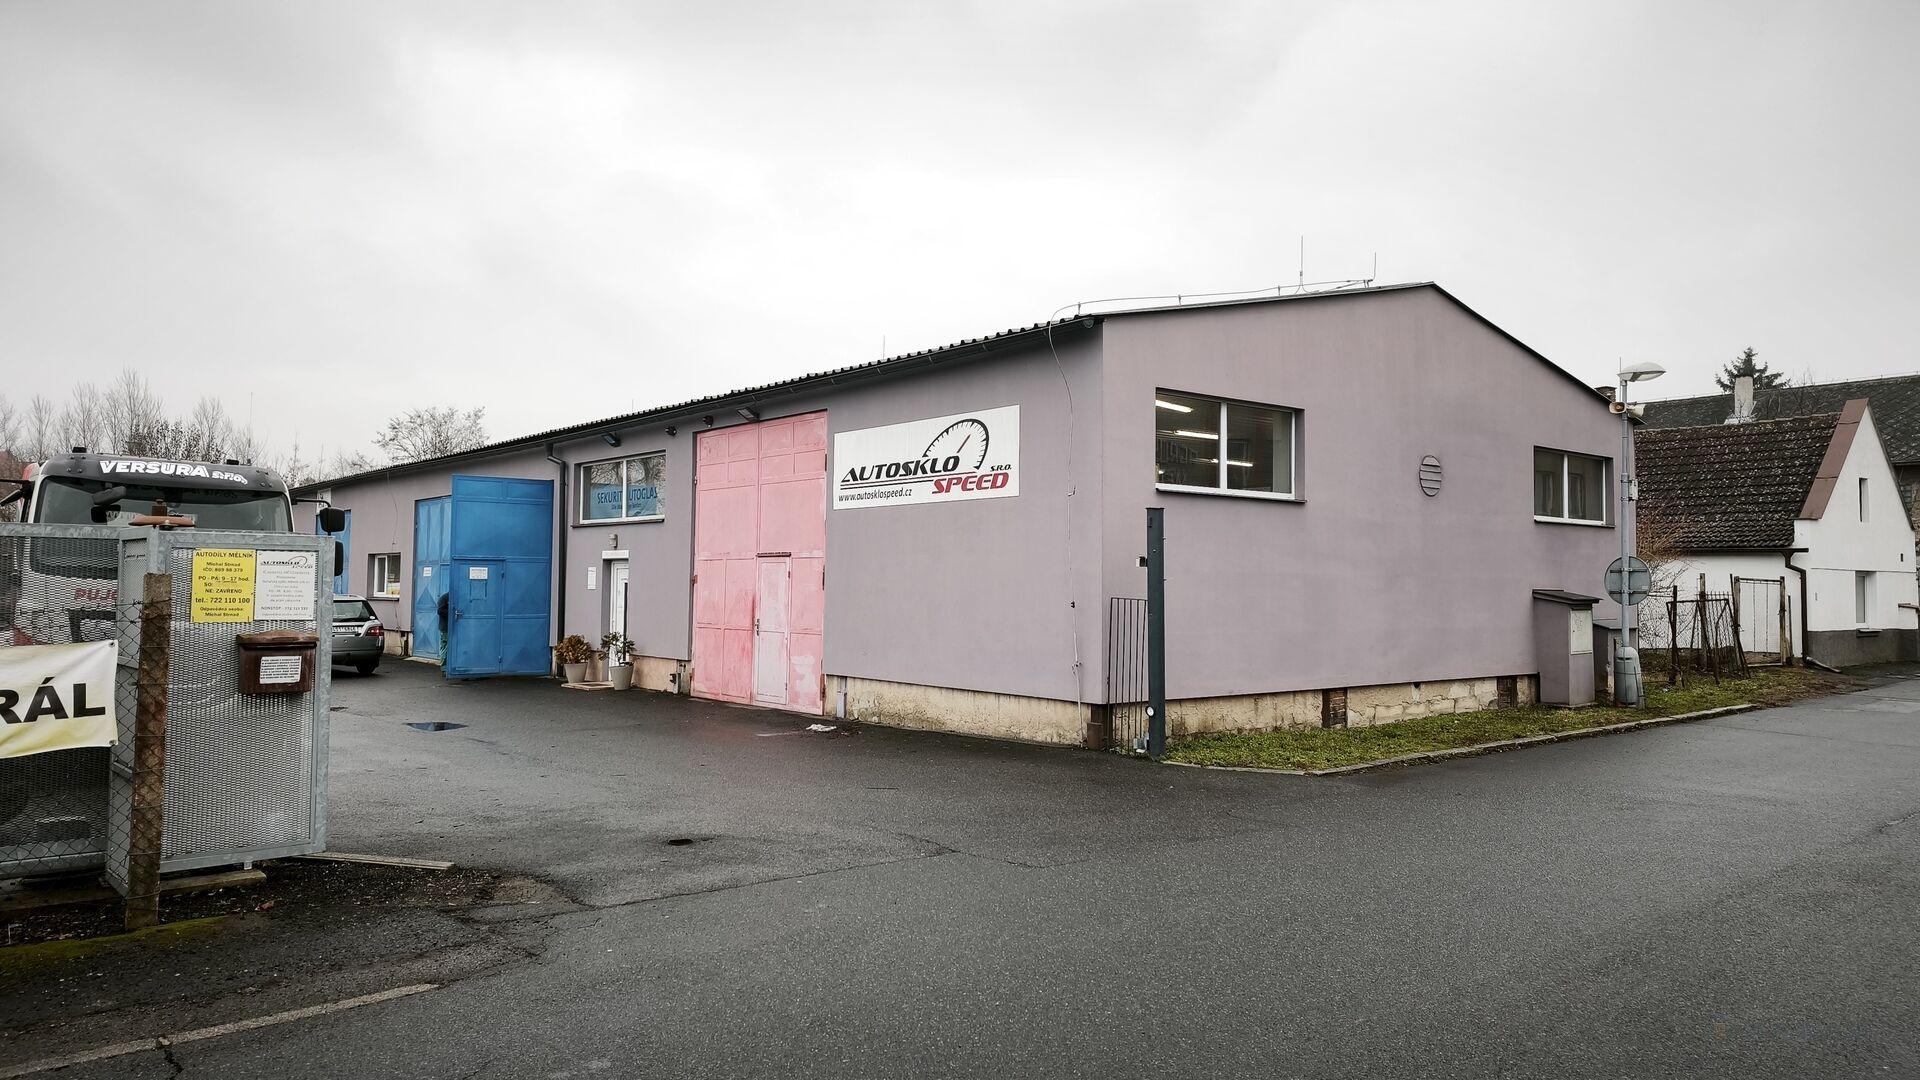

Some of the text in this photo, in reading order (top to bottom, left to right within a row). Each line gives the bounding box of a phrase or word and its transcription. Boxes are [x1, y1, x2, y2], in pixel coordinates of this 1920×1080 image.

[99, 460, 210, 478] VERSURA
[841, 455, 960, 483] AUTOSKLO
[931, 472, 1010, 494] SPEED
[597, 486, 658, 504] SEKURIT UTOGLAS
[838, 487, 913, 502] www.autosklospeed.cz
[0, 676, 106, 725] RÁL
